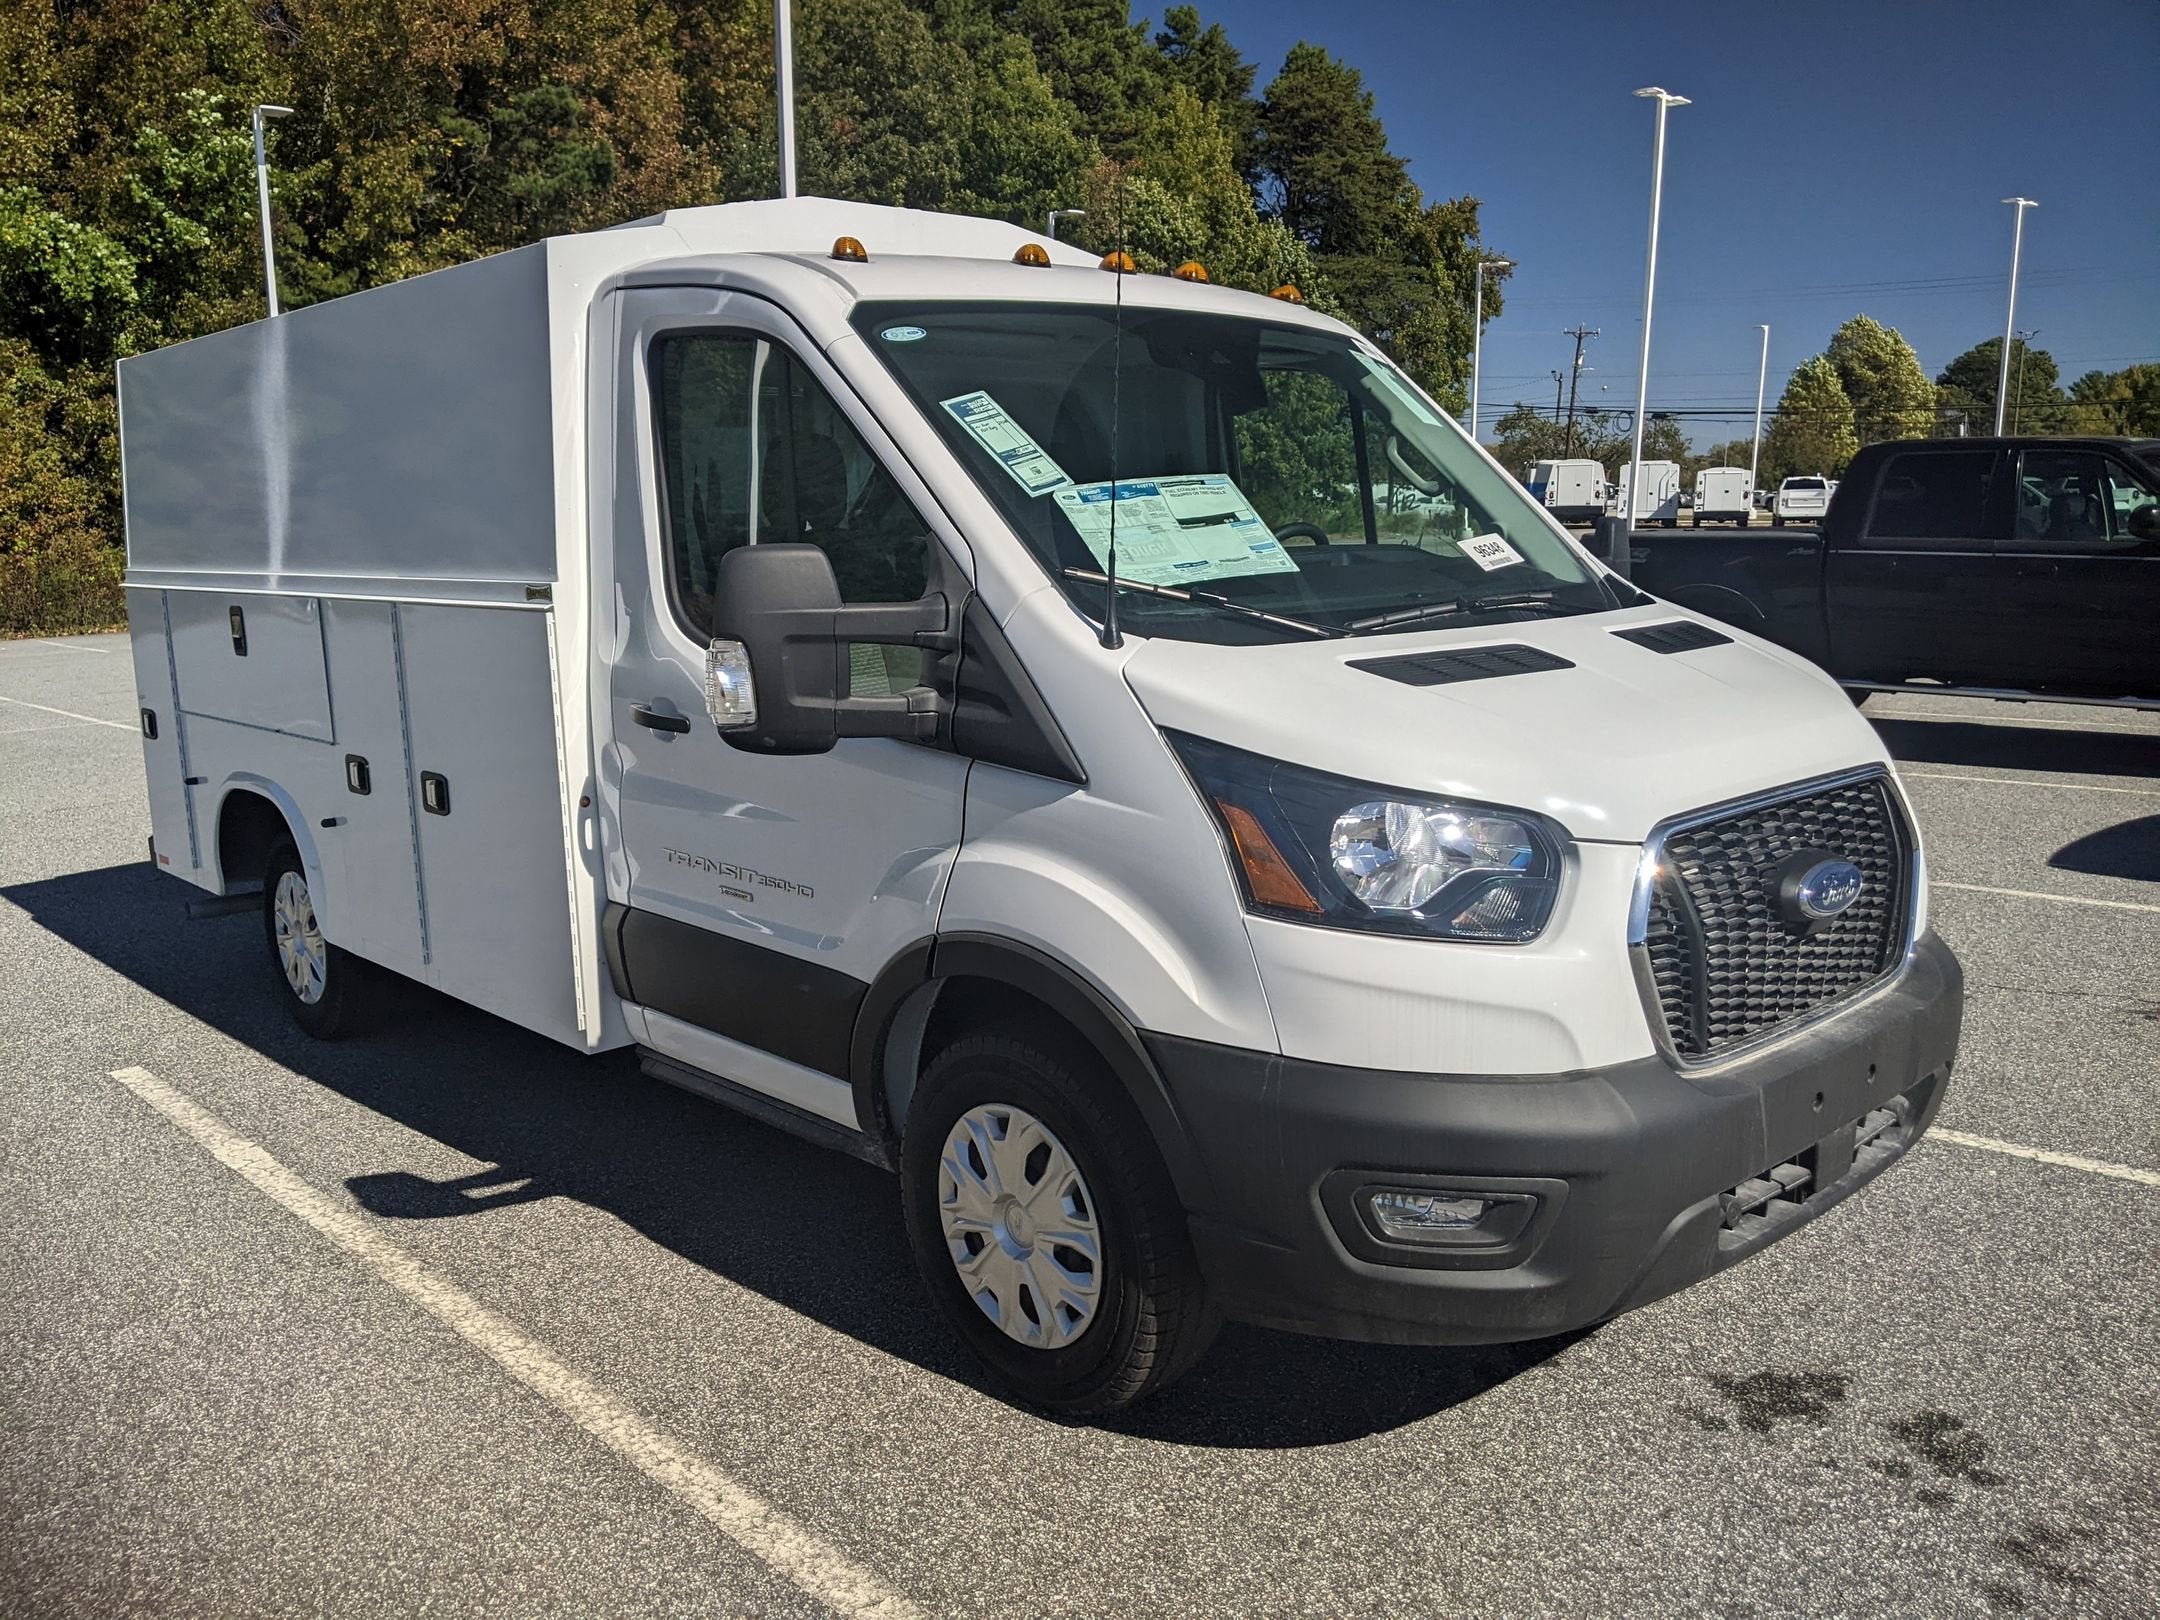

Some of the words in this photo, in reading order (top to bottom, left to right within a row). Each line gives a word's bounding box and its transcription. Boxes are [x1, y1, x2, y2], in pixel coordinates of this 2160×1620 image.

[1079, 488, 1101, 496] TRANSIT
[1473, 541, 1505, 557] 96348
[663, 847, 758, 883] TRANSIT
[1821, 873, 1857, 906] Ford
